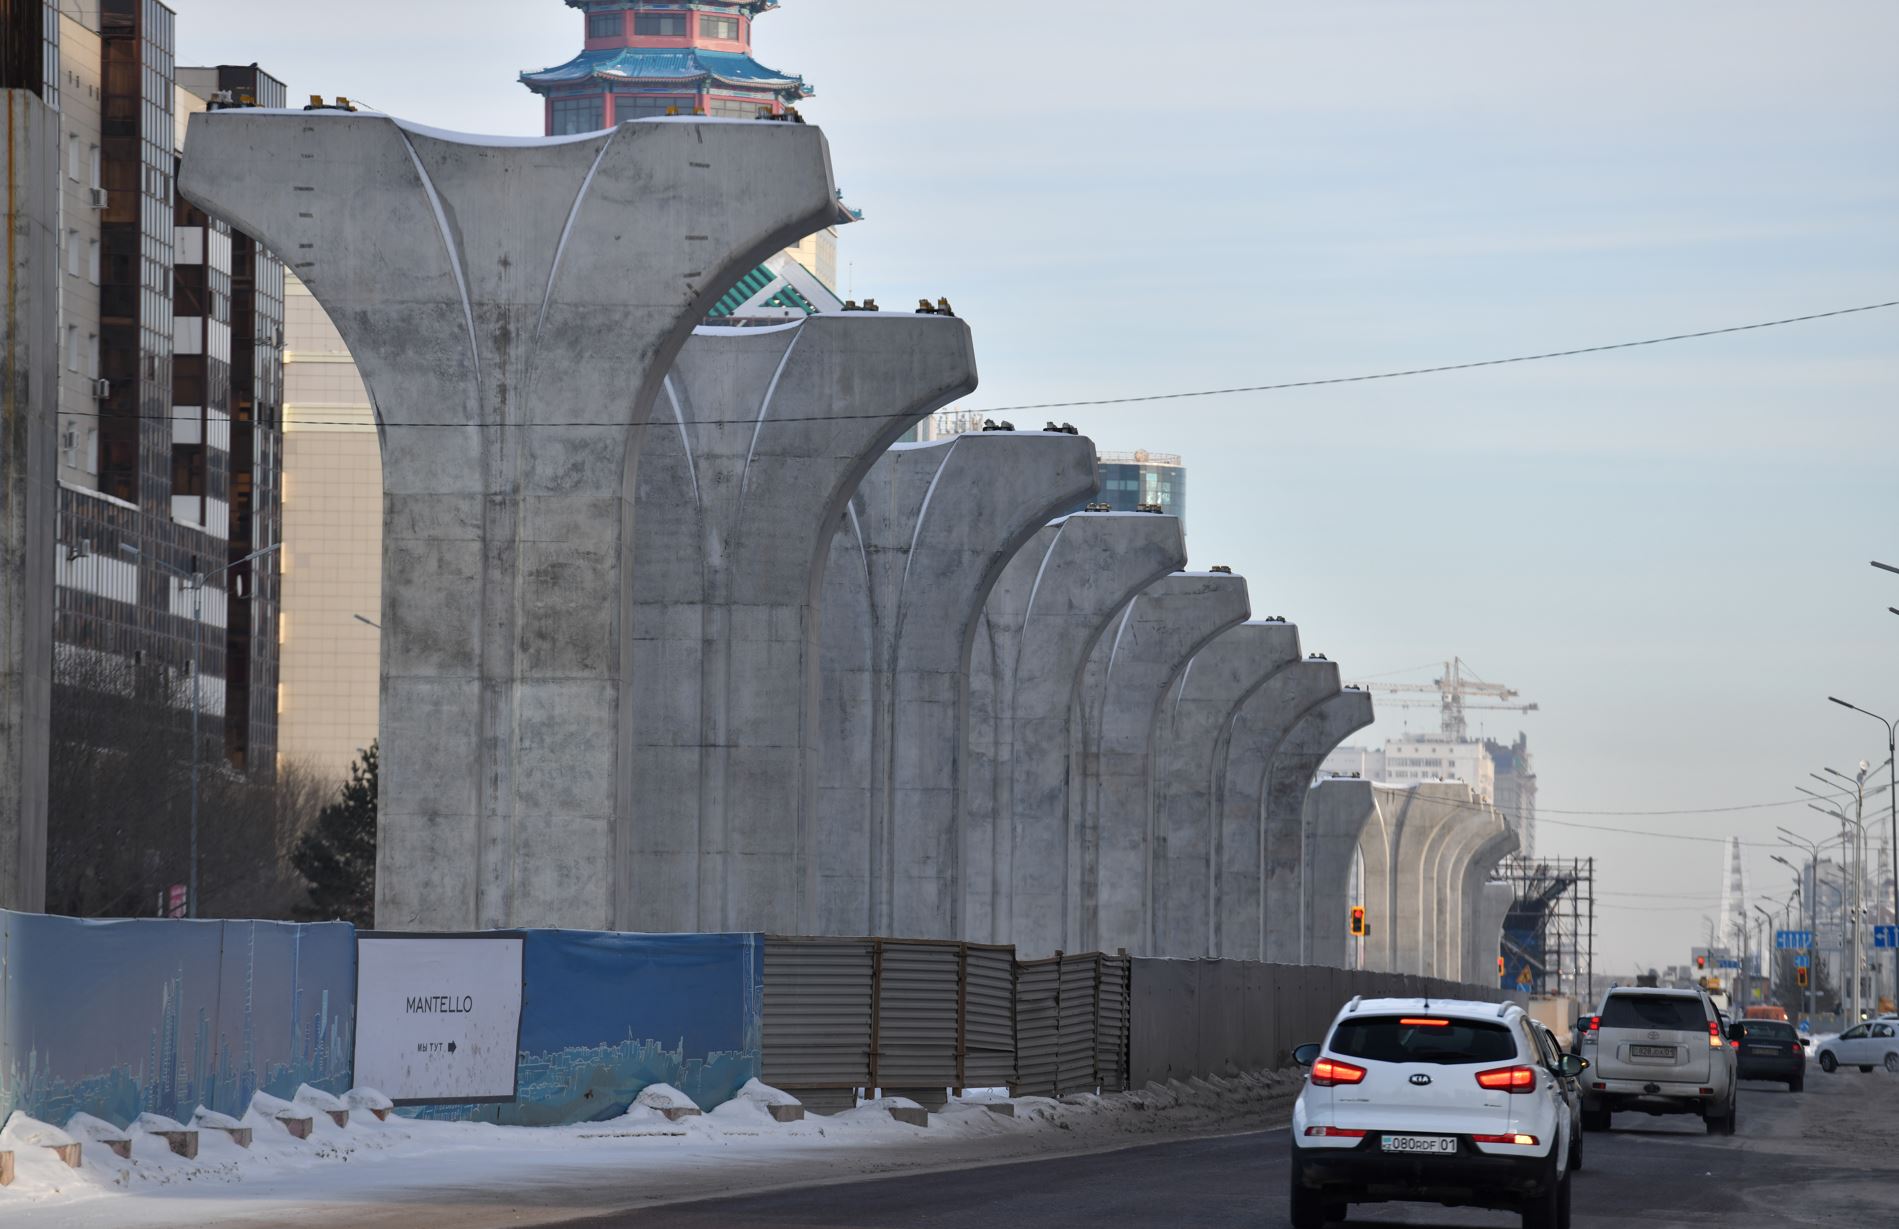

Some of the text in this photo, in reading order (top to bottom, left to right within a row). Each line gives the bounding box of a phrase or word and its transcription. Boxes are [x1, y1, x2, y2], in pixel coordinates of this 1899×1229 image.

[406, 995, 473, 1013] MANTELLO
[1411, 1075, 1429, 1083] KIA
[1440, 1138, 1456, 1151] 01
